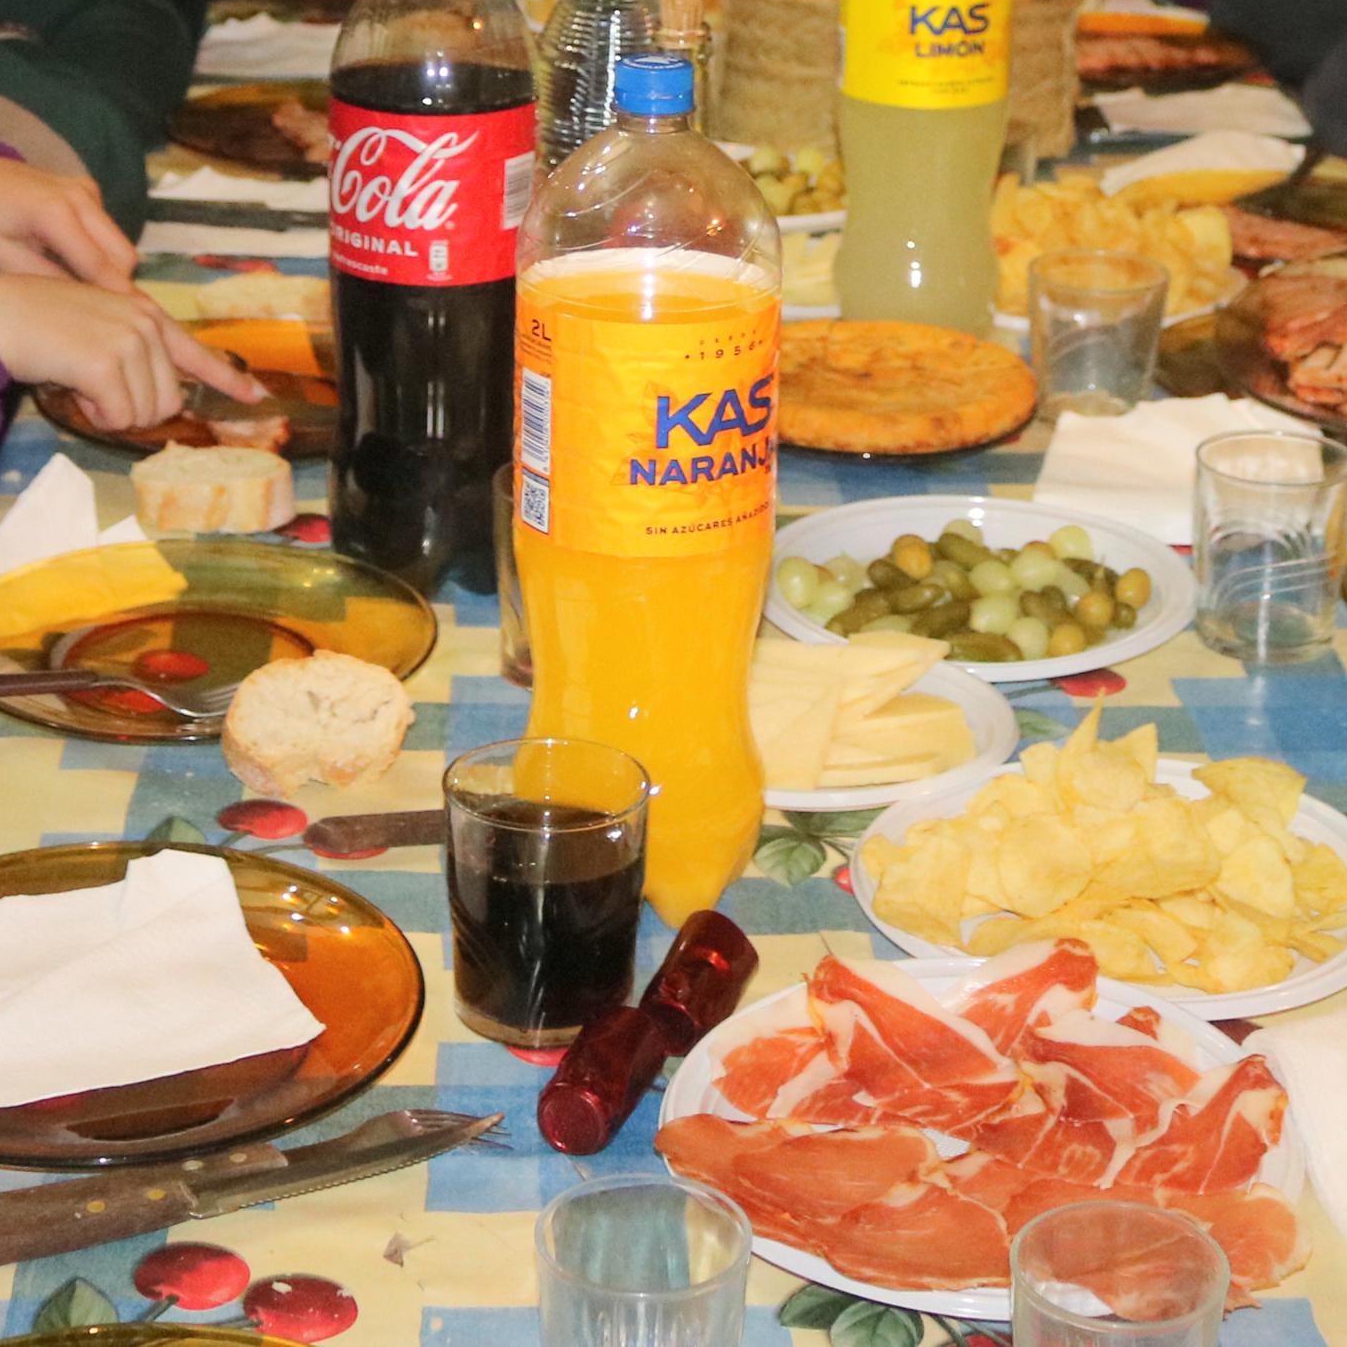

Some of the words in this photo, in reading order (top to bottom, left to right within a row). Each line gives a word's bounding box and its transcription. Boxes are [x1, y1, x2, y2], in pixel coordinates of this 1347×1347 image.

[909, 3, 990, 36] KAS
[531, 319, 552, 341] 2L
[655, 375, 775, 449] KAS
[645, 526, 668, 535] SIN
